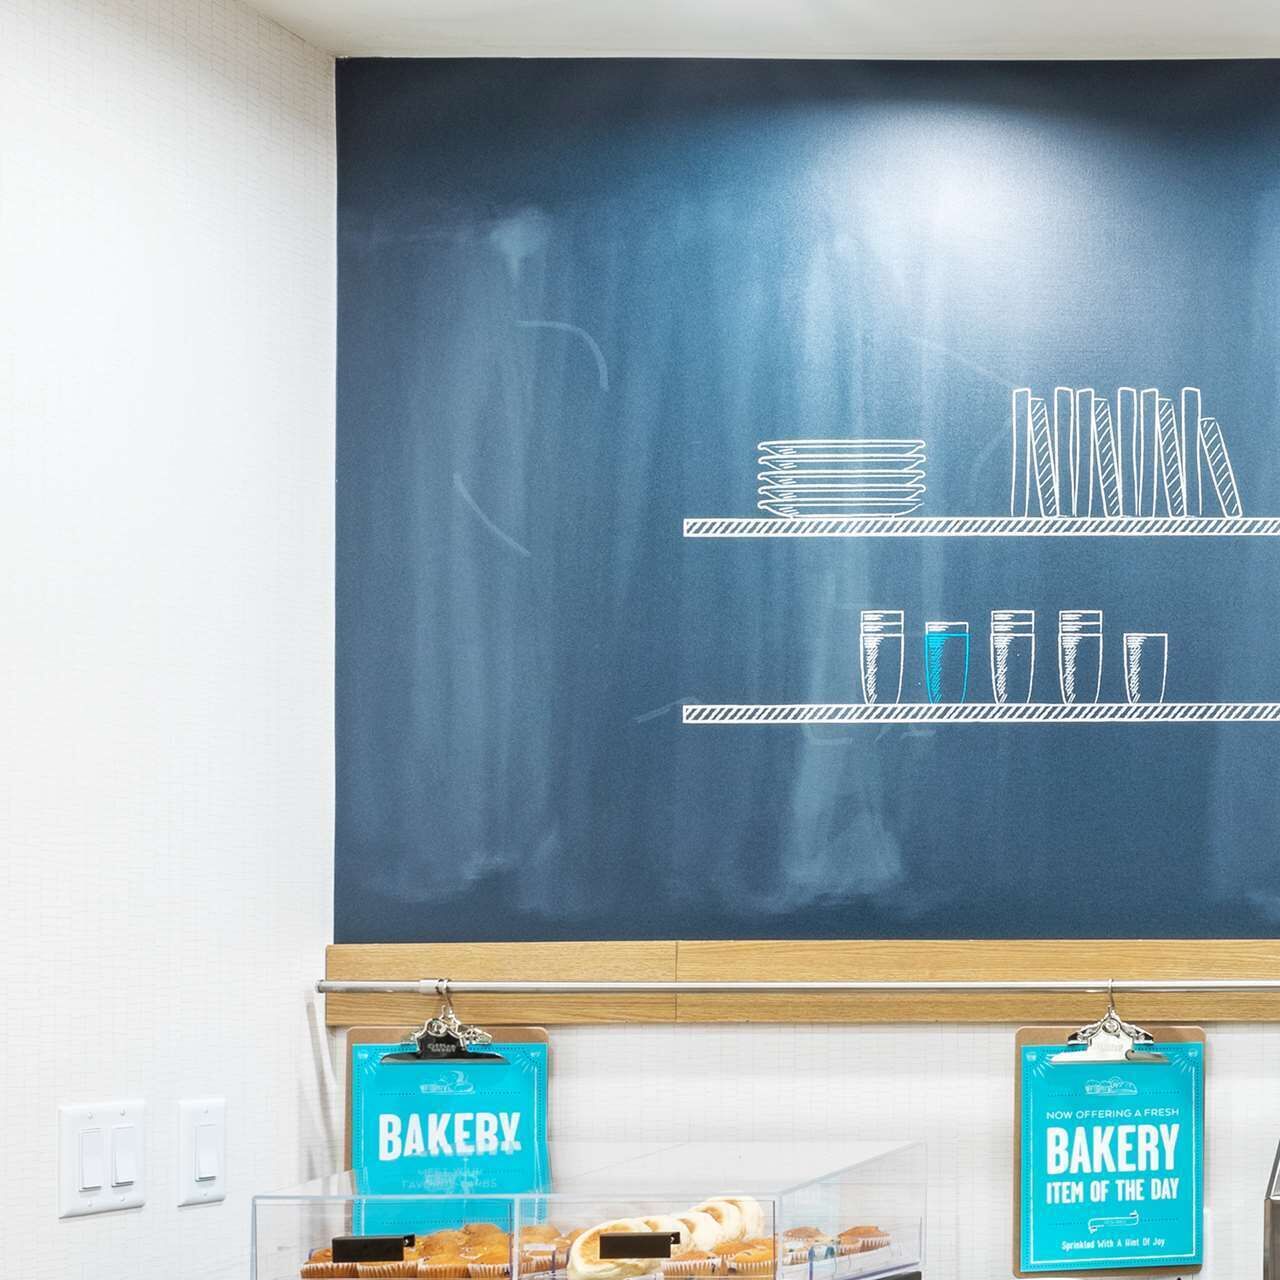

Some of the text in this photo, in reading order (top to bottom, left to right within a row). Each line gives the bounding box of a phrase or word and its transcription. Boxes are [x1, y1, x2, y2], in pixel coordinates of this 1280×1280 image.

[1046, 1107, 1179, 1120] NOW OFFERING A FRESH
[378, 1111, 521, 1161] BAKERY
[1046, 1123, 1180, 1174] BAKERY
[1046, 1177, 1180, 1205] ITEM OF THE DAY
